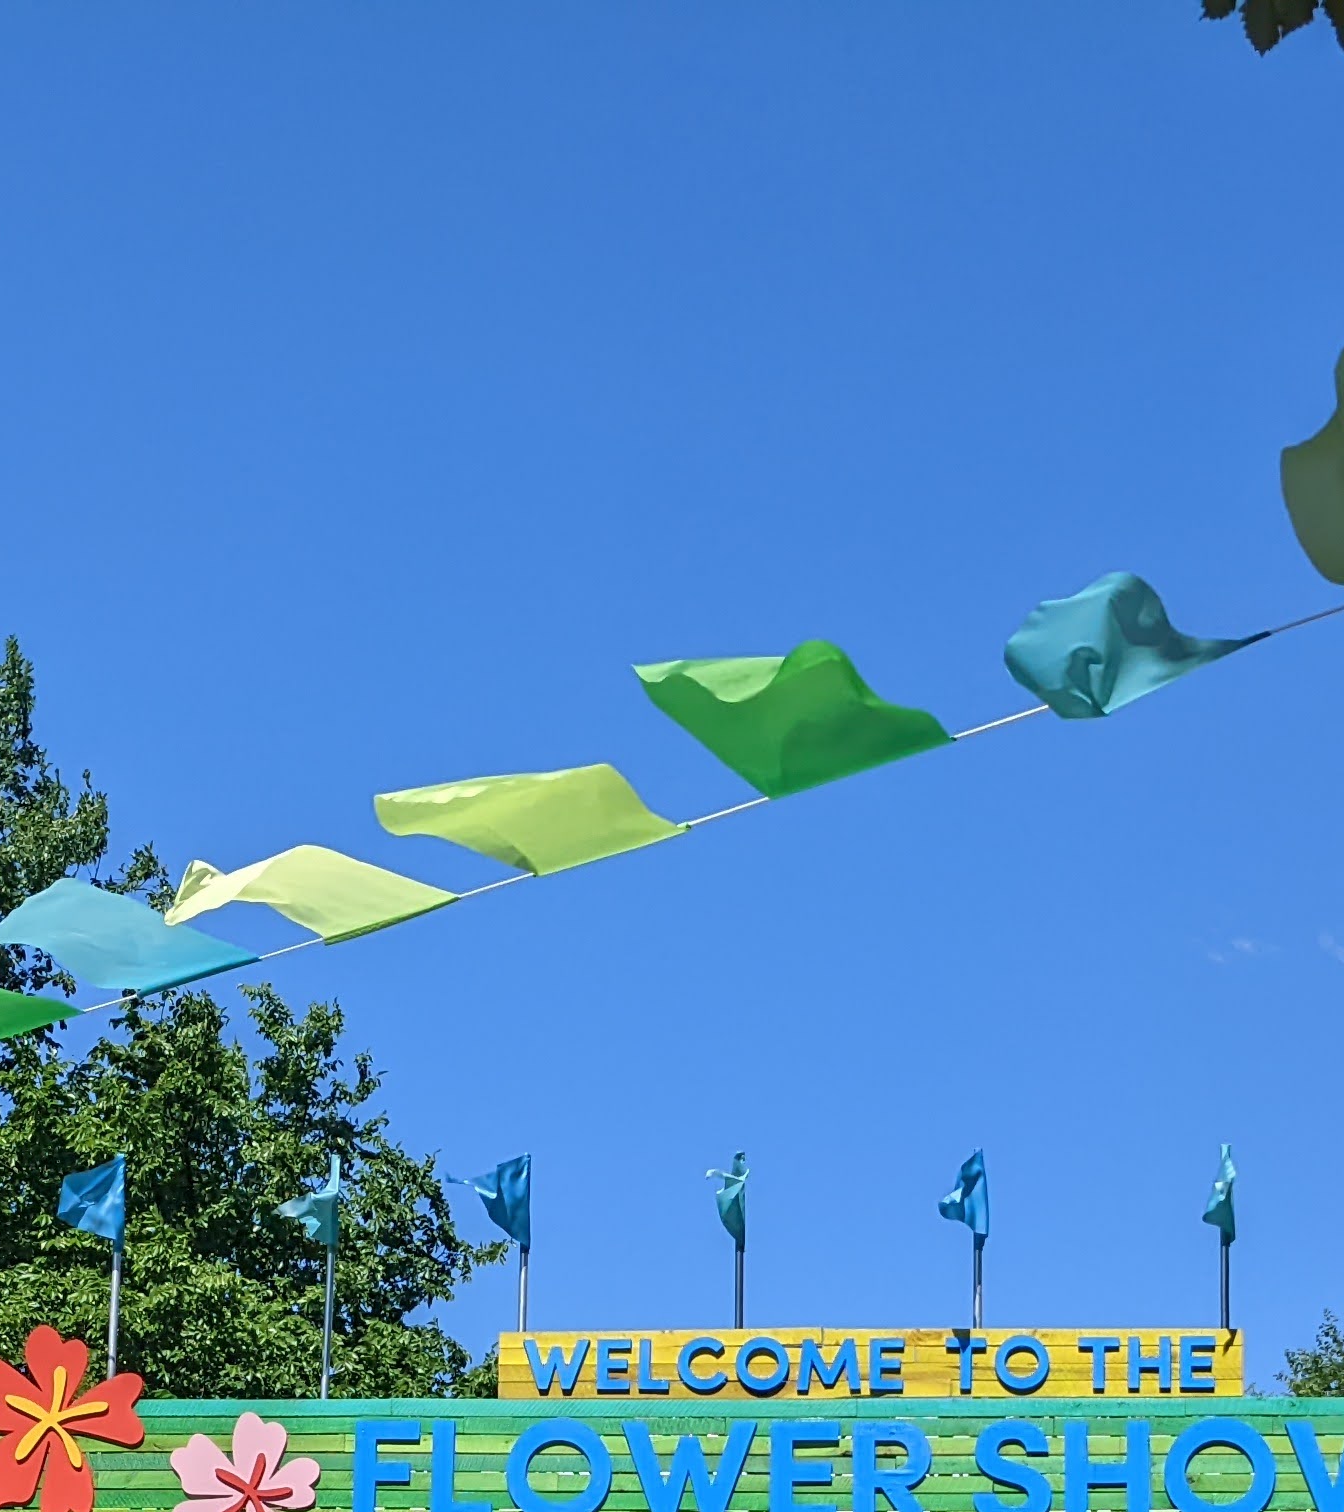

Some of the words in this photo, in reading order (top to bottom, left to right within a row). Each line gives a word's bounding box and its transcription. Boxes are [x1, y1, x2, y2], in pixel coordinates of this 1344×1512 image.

[523, 1337, 903, 1395] WELCOME
[945, 1335, 1050, 1395] TO
[1078, 1336, 1216, 1393] THE
